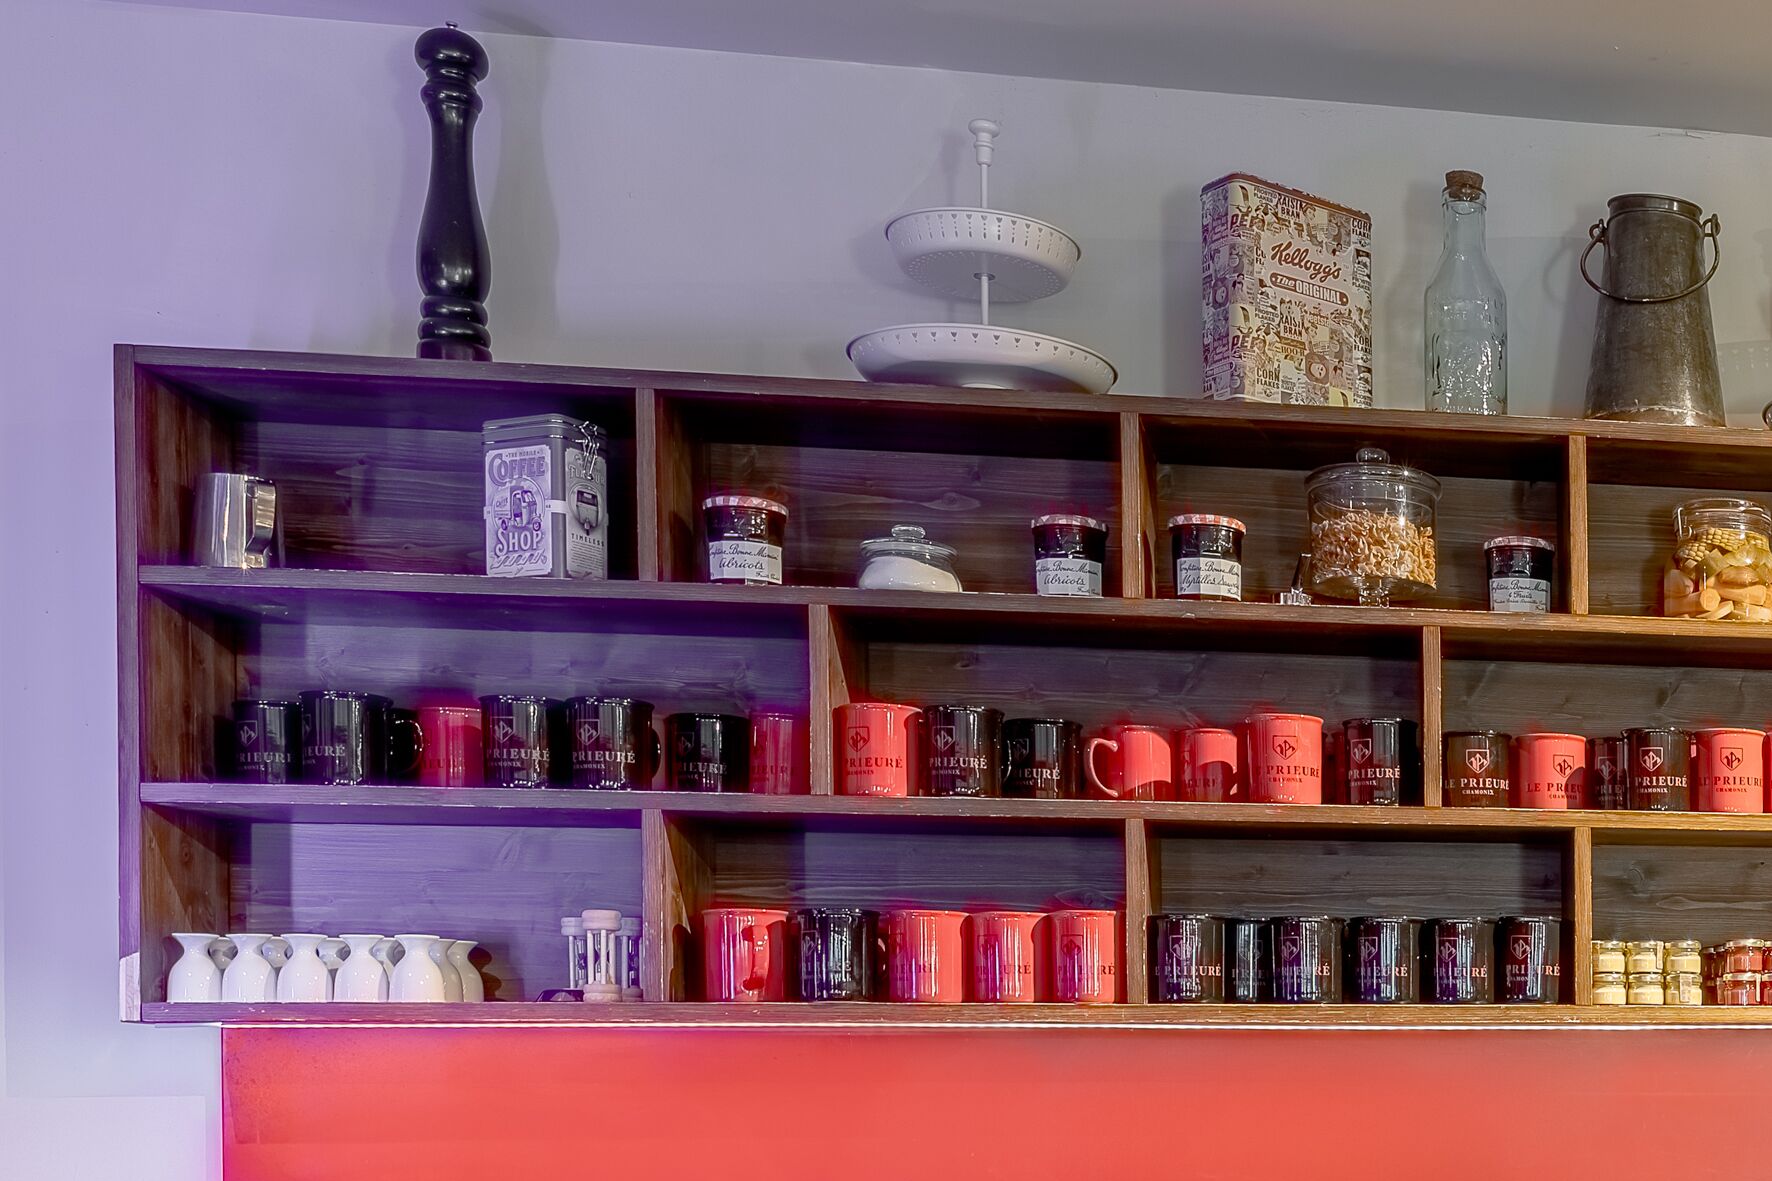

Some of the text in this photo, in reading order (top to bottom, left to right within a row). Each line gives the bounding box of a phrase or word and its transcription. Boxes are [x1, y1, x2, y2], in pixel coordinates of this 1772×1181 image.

[1281, 206, 1301, 219] BRAN
[1271, 241, 1342, 283] Kellogg's
[1276, 275, 1342, 304] The ORIGINAL
[1283, 326, 1302, 338] BRAN
[1256, 366, 1281, 382] CORN
[1256, 377, 1281, 390] FLAKES
[488, 453, 546, 487] COFFEE
[495, 528, 543, 557] SHOP
[571, 533, 605, 547] TIMELESS
[719, 558, 764, 570] Abricots
[1044, 574, 1087, 586] Abricots
[1348, 765, 1401, 780] PRIEURÉ
[1445, 776, 1510, 791] LE PRIEURÉ
[1527, 782, 1541, 794] LE
[1634, 775, 1689, 788] PRIEURÉ
